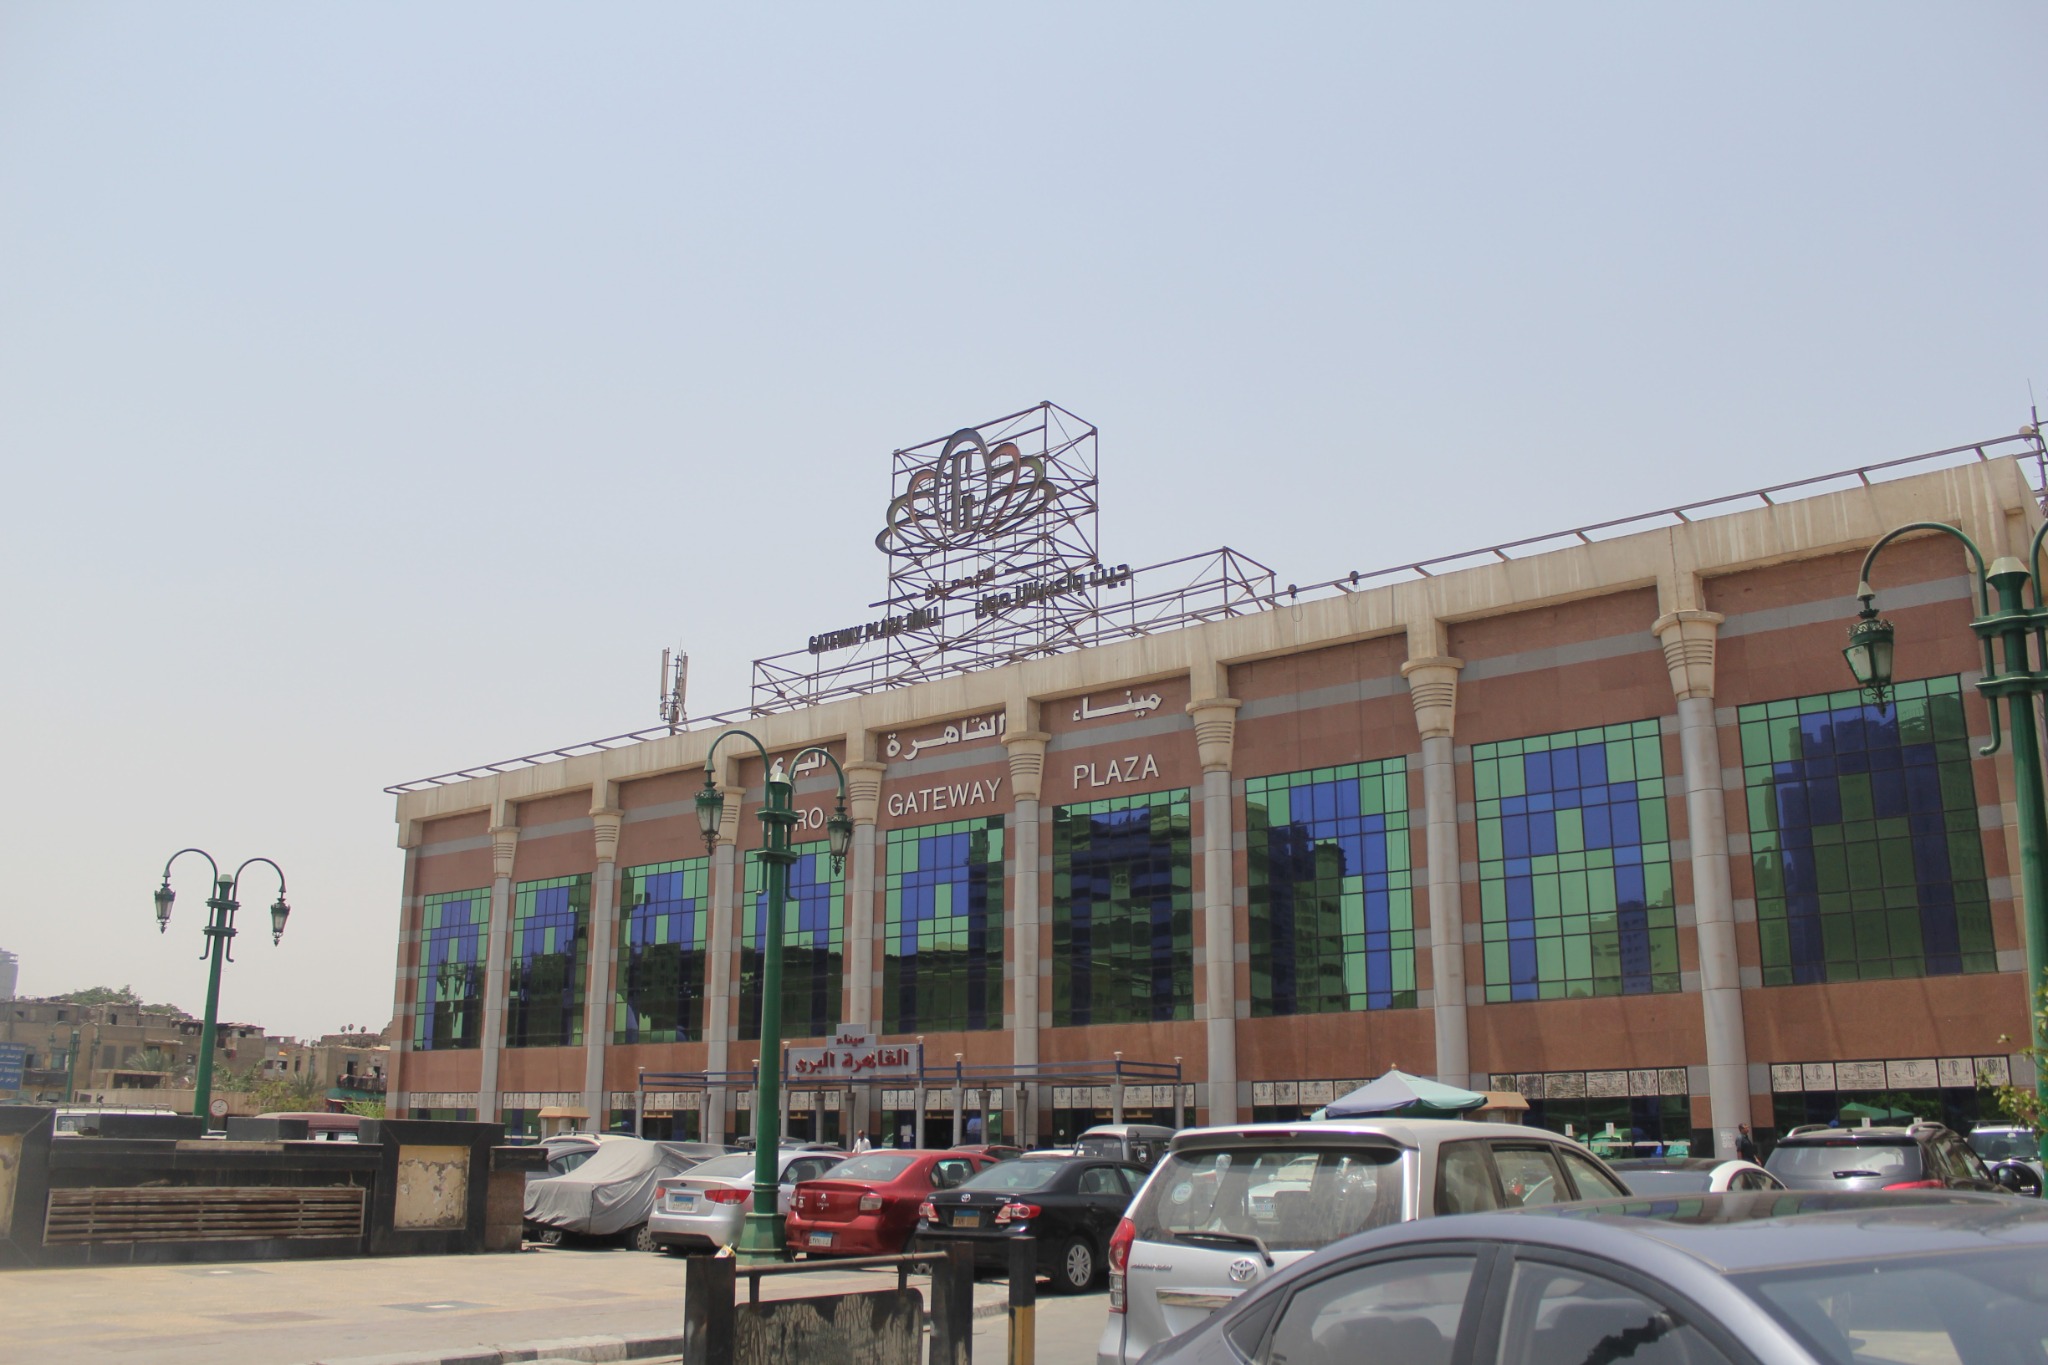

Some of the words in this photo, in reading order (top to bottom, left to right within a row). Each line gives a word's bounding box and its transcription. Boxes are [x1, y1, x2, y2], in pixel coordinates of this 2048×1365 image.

[808, 624, 864, 655] GATEWAY
[865, 614, 904, 643] PLAZA
[1072, 690, 1163, 722] ميناء
[886, 712, 1006, 760] القاهرة
[887, 777, 1002, 817] GATEWAY
[1073, 753, 1160, 790] PLAZA
[841, 1048, 909, 1073] القاهرة
